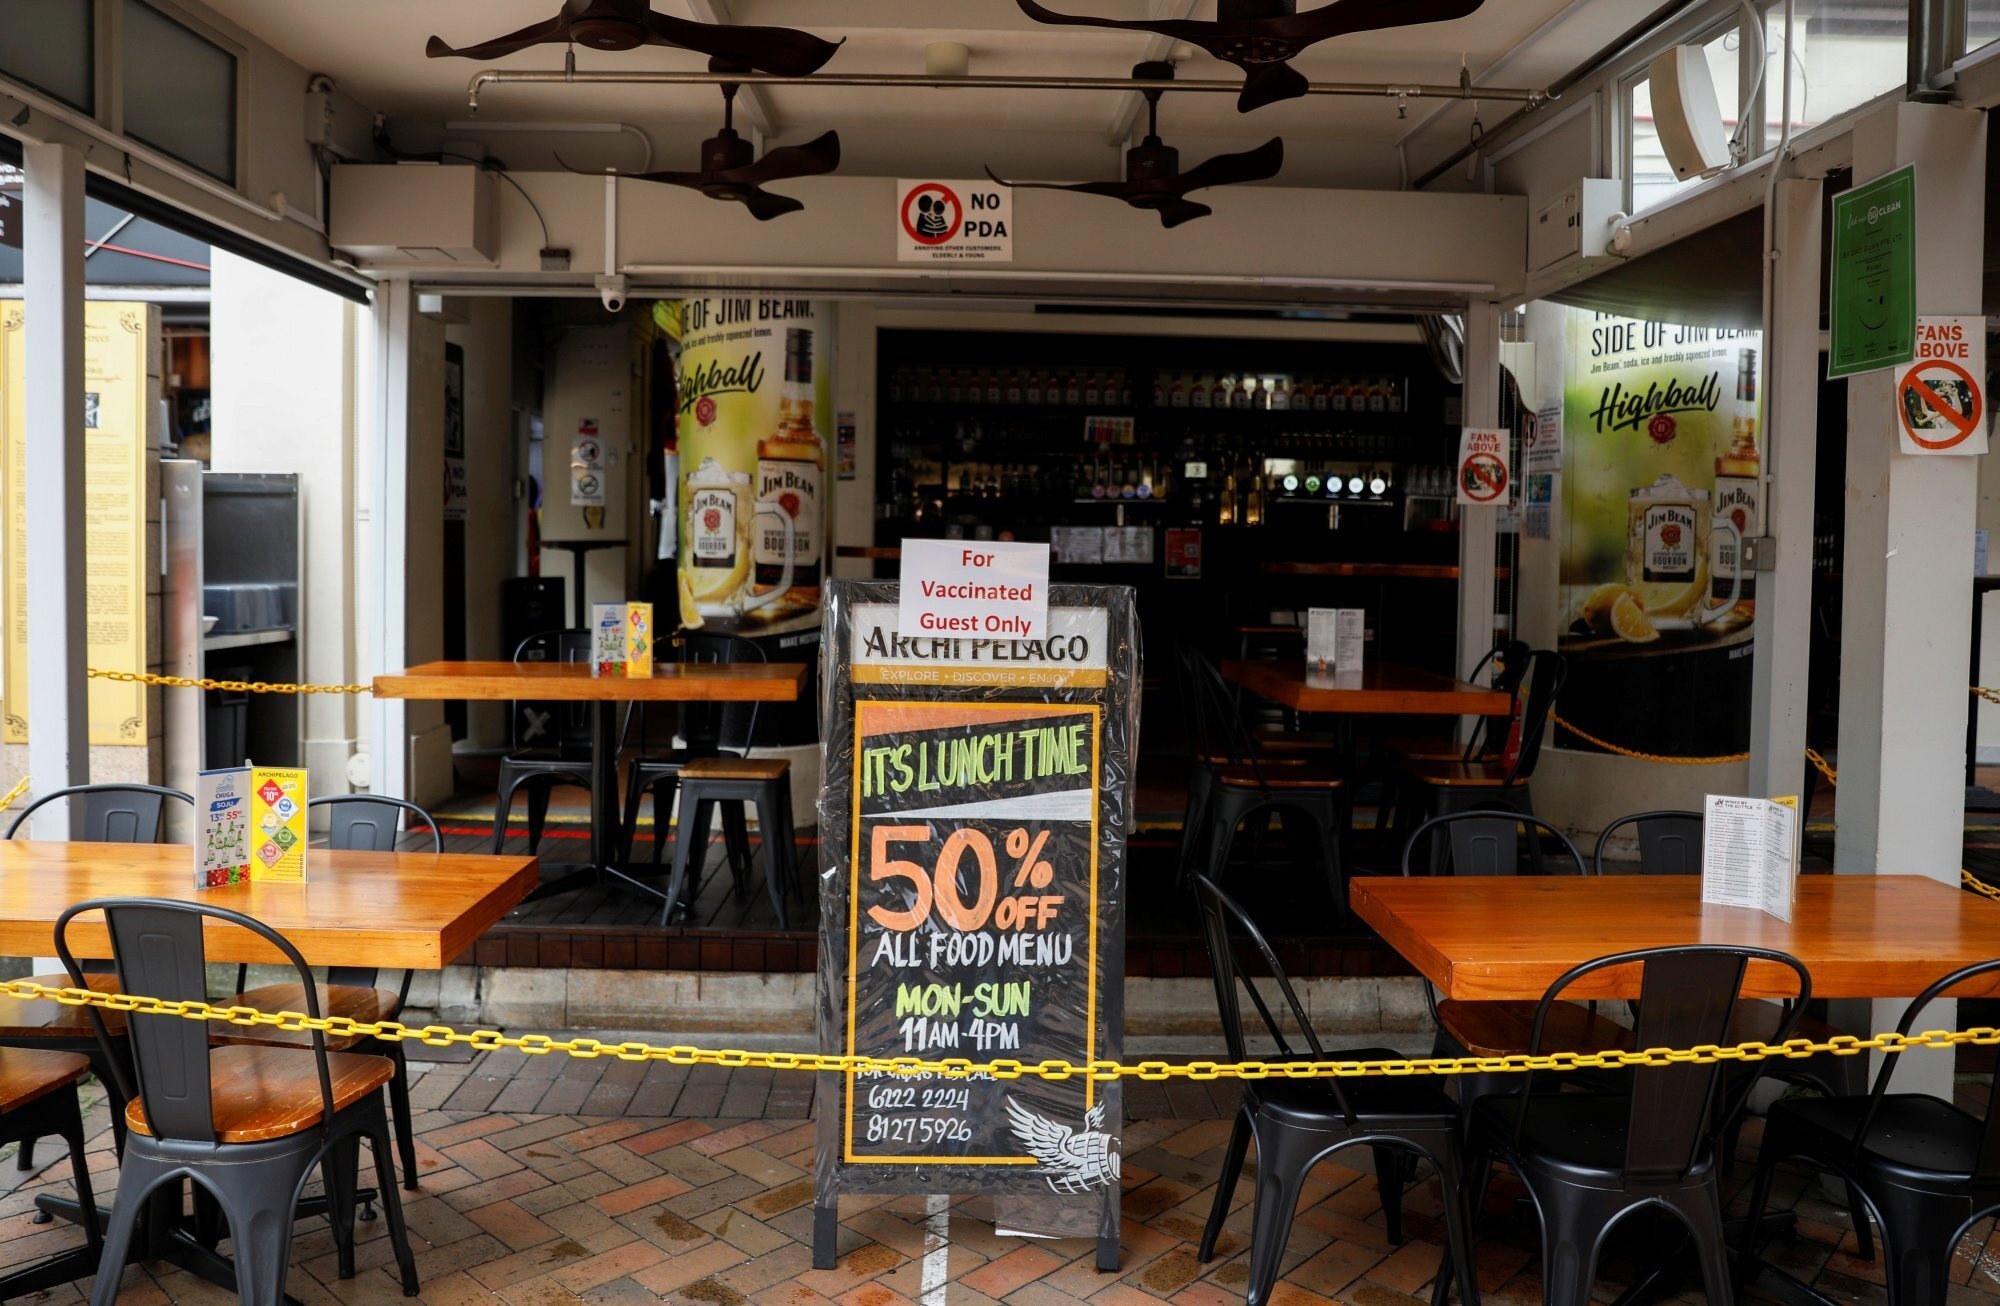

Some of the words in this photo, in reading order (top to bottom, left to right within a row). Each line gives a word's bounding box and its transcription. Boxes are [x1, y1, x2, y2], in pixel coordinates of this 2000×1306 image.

[971, 193, 1000, 209] NO
[1879, 201, 1901, 215] CLEAN
[964, 221, 1007, 237] PDA
[716, 299, 751, 324] JIM
[1592, 322, 1636, 357] SIDE
[1644, 320, 1666, 348] OF
[1916, 325, 1963, 341] FANS
[1591, 363, 1601, 374] Jim
[1652, 356, 1662, 365] and
[1664, 352, 1684, 363] freshly
[1686, 349, 1710, 361] squeezed
[681, 351, 764, 414] ighball
[1590, 371, 1720, 434] Highball
[1467, 443, 1501, 452] ABOVE
[1470, 433, 1497, 443] FANS
[760, 475, 782, 497] JIM
[785, 471, 814, 500] BEAM
[695, 498, 707, 514] JIM
[709, 494, 732, 514] BEAM
[1717, 491, 1735, 513] JIM
[1648, 513, 1665, 530] JIM
[1668, 509, 1692, 530] BEAM
[962, 550, 994, 567] For
[921, 580, 1032, 601] Vaccinated
[920, 613, 979, 631] Guest
[985, 615, 1032, 637] Only
[882, 671, 940, 681] EXPLORE
[953, 671, 1016, 682] DISCOVER
[1029, 673, 1070, 683] ENJOY
[918, 731, 1013, 791] LUNCH
[1019, 724, 1088, 781] TIME
[216, 798, 234, 808] SOJU
[995, 896, 1065, 931] OFF
[871, 931, 923, 967] ALL
[930, 931, 994, 969] FOOD
[997, 932, 1073, 967] MENU
[869, 1084, 916, 1109] 6222
[922, 1087, 969, 1111] 2224
